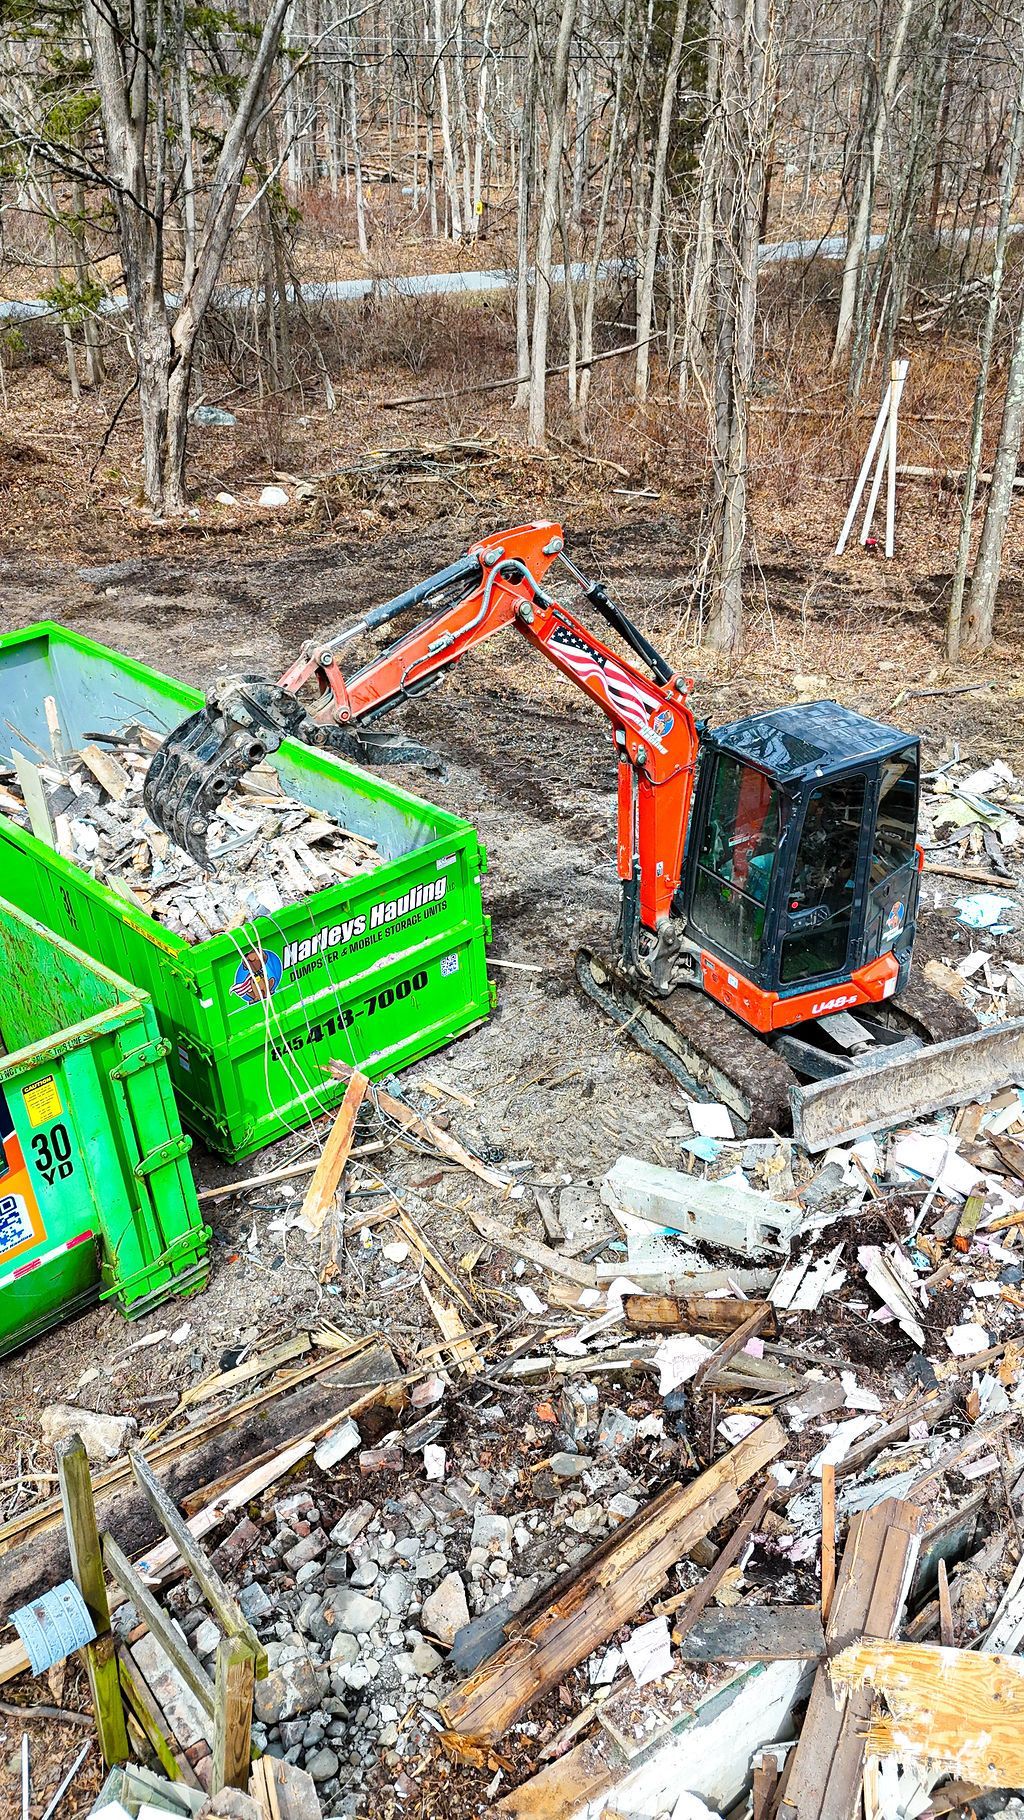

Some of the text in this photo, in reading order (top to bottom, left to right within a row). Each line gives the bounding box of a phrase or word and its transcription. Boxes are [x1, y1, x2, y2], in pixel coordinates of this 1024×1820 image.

[283, 914, 366, 970] Harleys
[370, 875, 447, 930] Hauling
[290, 901, 447, 982] DUMPSTER & MOBILE STORAGE UNITS
[23, 1076, 52, 1093] CAUTION
[31, 1123, 72, 1172] 30
[41, 1160, 74, 1186] YD
